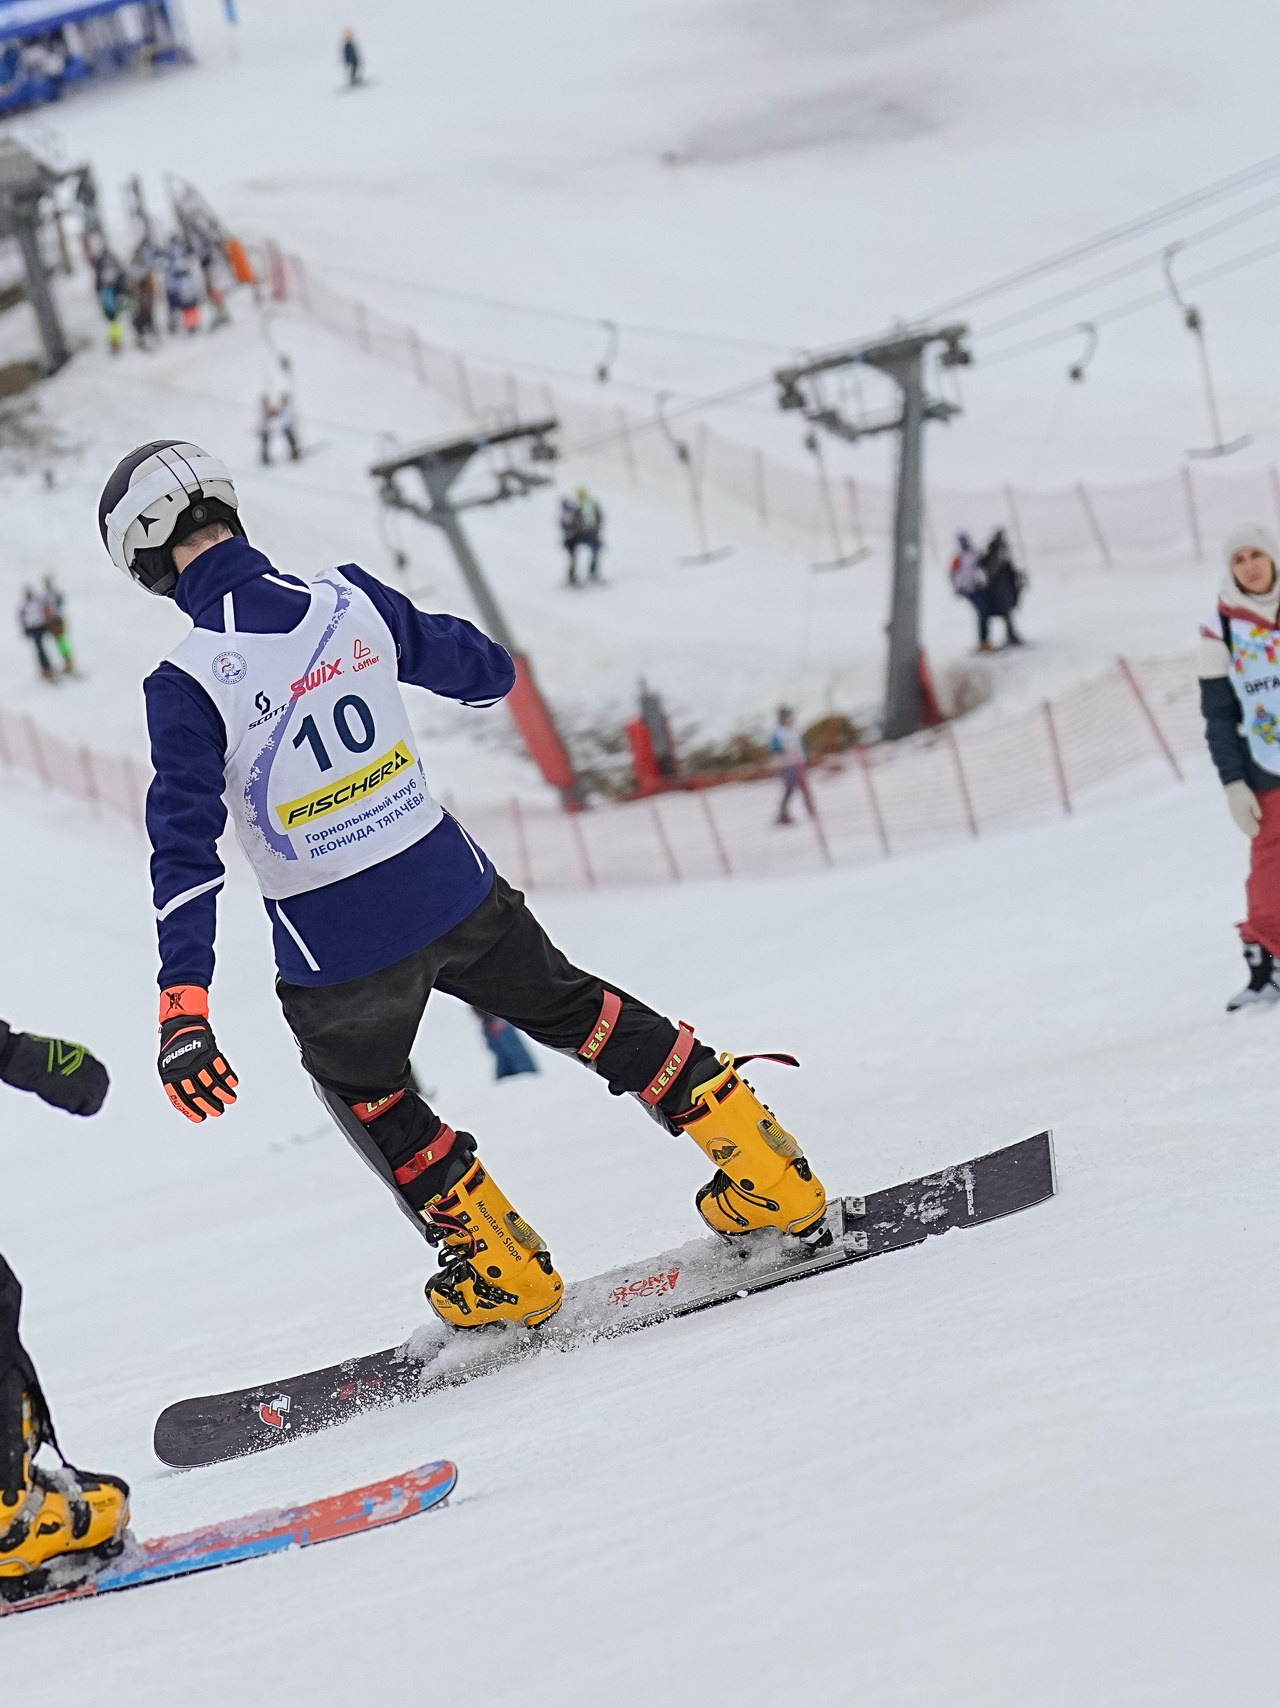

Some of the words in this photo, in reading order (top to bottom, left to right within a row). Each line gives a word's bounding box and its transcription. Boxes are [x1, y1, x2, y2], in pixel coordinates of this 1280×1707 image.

[248, 703, 287, 730] SCOTT
[292, 694, 376, 773] 10
[288, 761, 393, 825] FISCHER
[305, 796, 393, 843] Горнолыжный
[392, 779, 417, 801] клуб
[310, 825, 375, 858] ЛЕОНИДА
[376, 792, 424, 829] ТЯГАЧЁВА
[162, 1039, 202, 1069] reusch
[583, 1019, 610, 1060] LEKI
[651, 1053, 682, 1096] LEKI
[476, 1200, 504, 1238] Mountain
[503, 1237, 522, 1262] Slope
